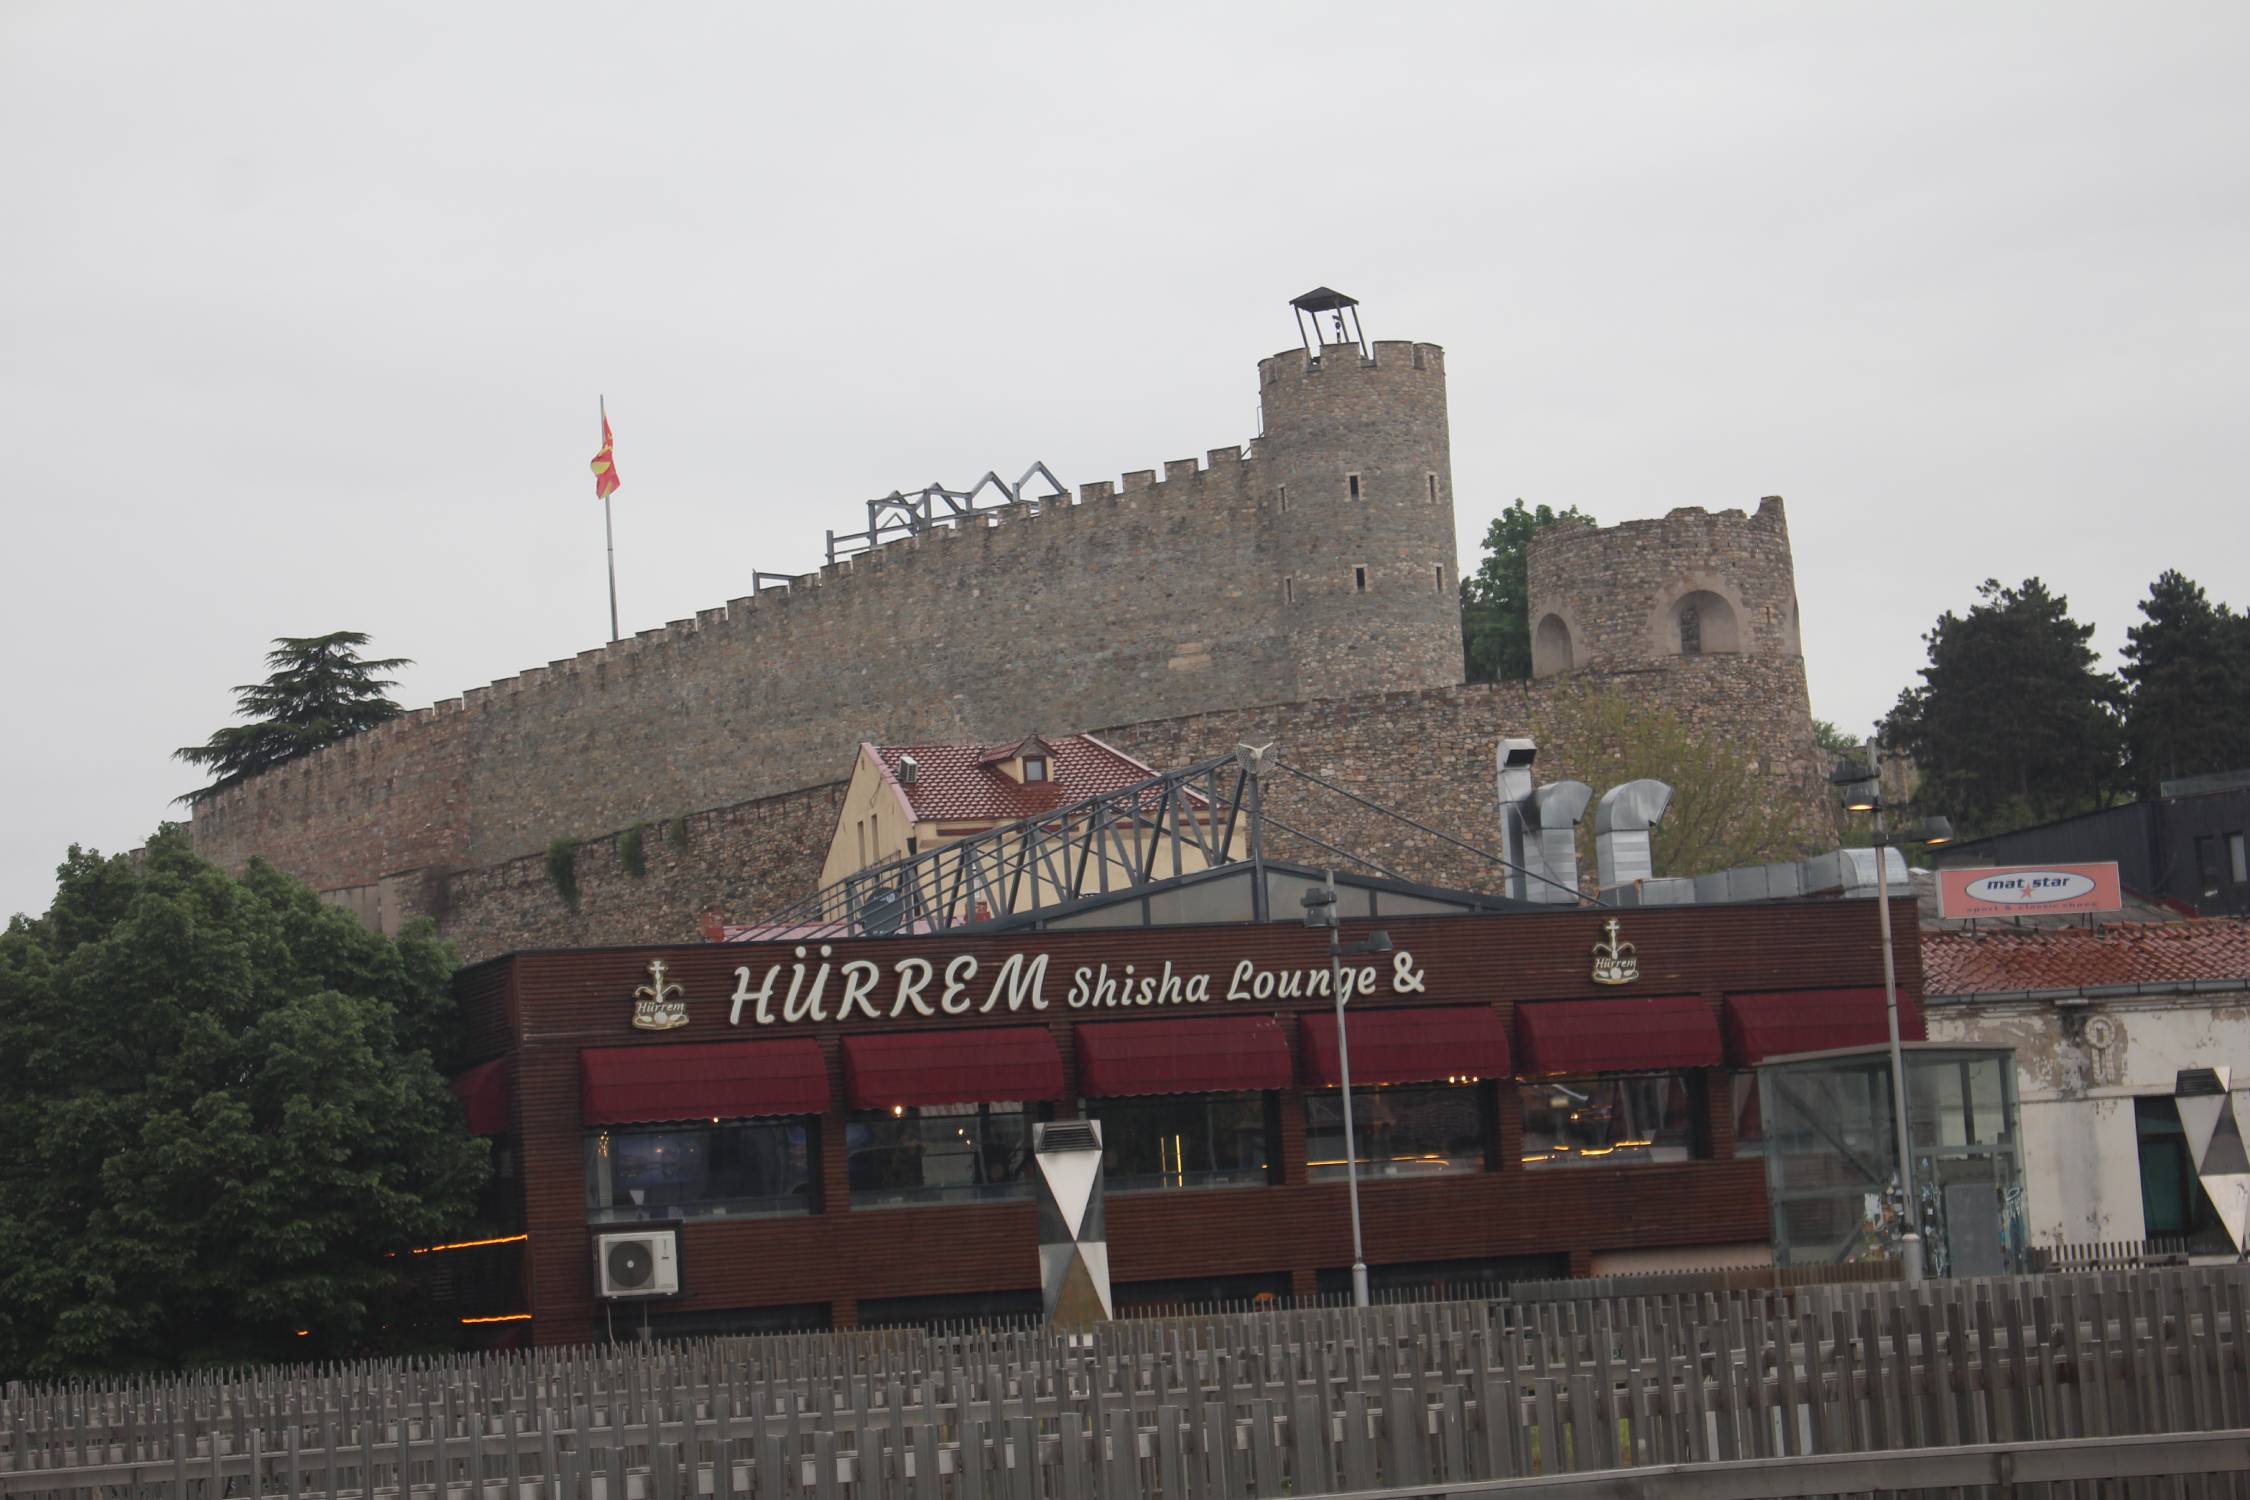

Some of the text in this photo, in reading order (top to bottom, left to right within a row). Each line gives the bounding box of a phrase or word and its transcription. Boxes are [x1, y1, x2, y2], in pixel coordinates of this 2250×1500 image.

[1987, 877, 2071, 890] mat star
[729, 945, 1426, 1026] HÜRREM Shisha Lounge &
[638, 1002, 684, 1013] Hürrem
